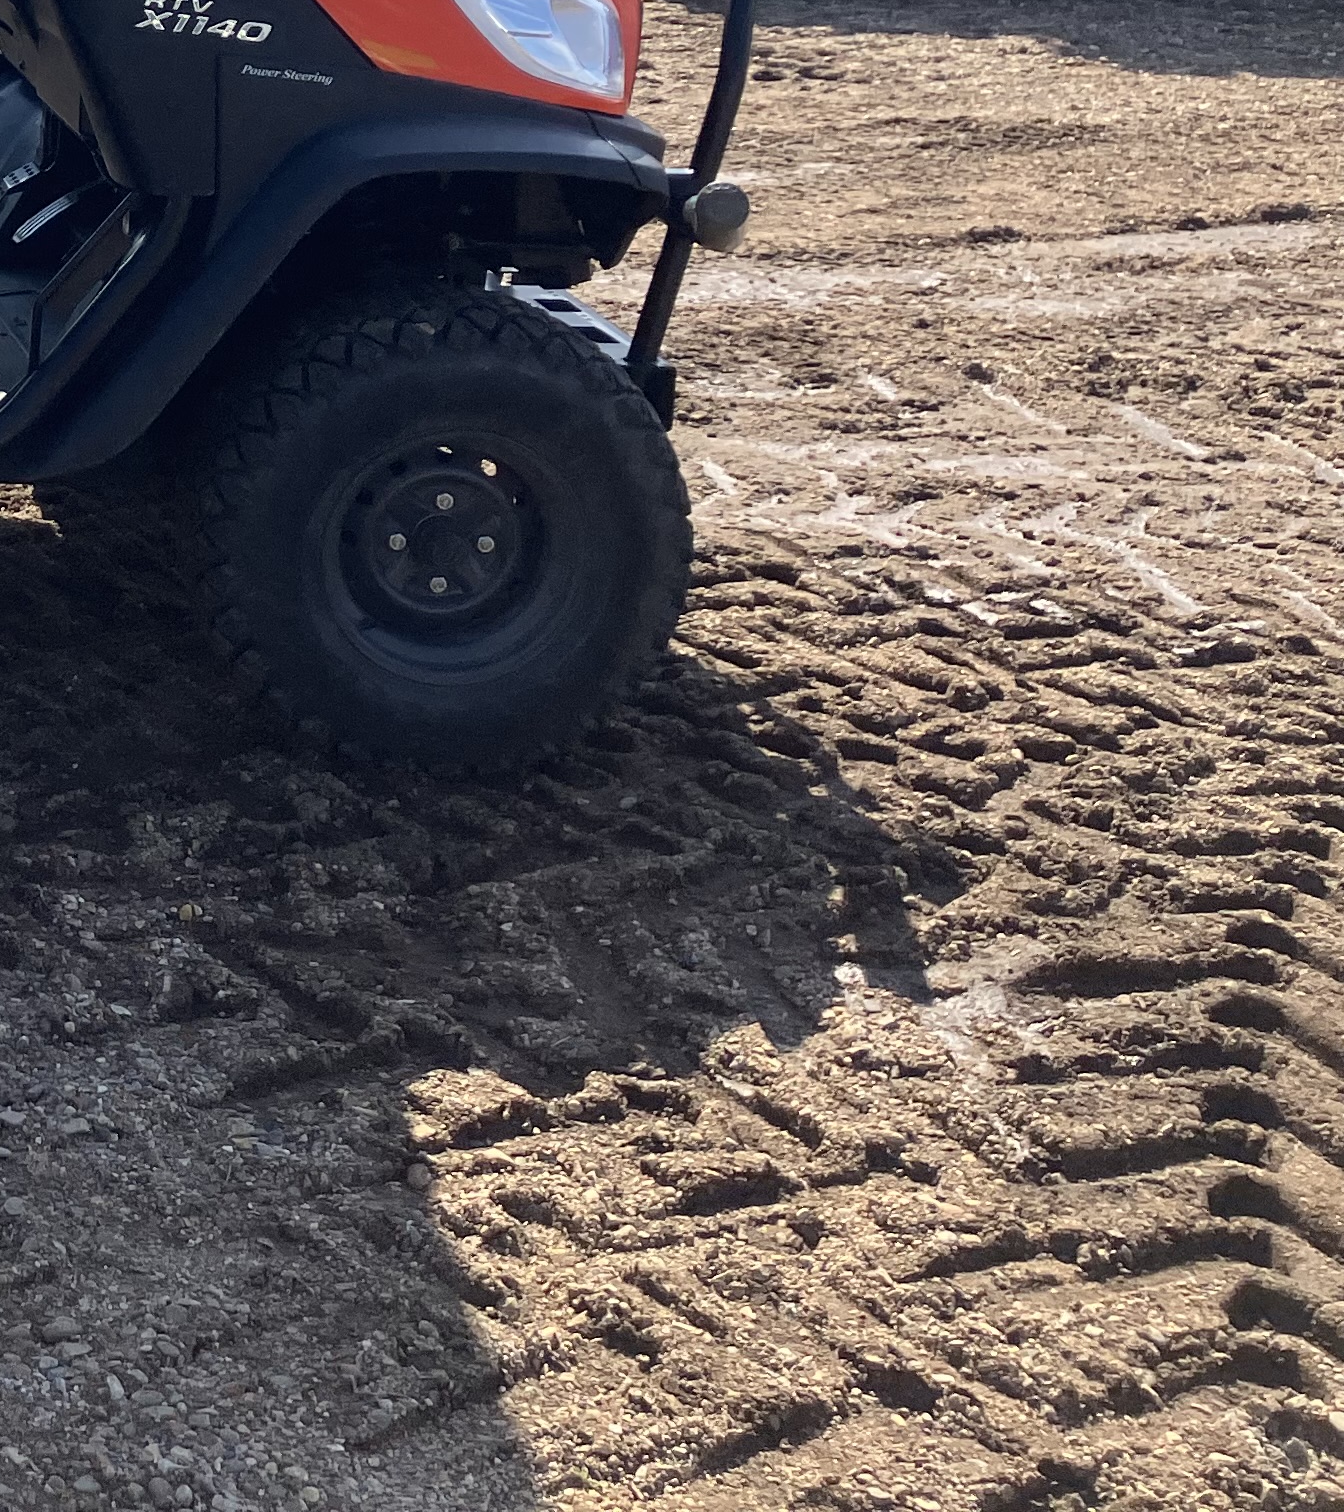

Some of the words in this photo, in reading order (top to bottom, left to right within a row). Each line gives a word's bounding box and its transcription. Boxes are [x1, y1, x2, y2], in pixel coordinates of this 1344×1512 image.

[134, 9, 273, 42] X1140
[241, 64, 281, 78] Power
[282, 69, 334, 86] Steering
